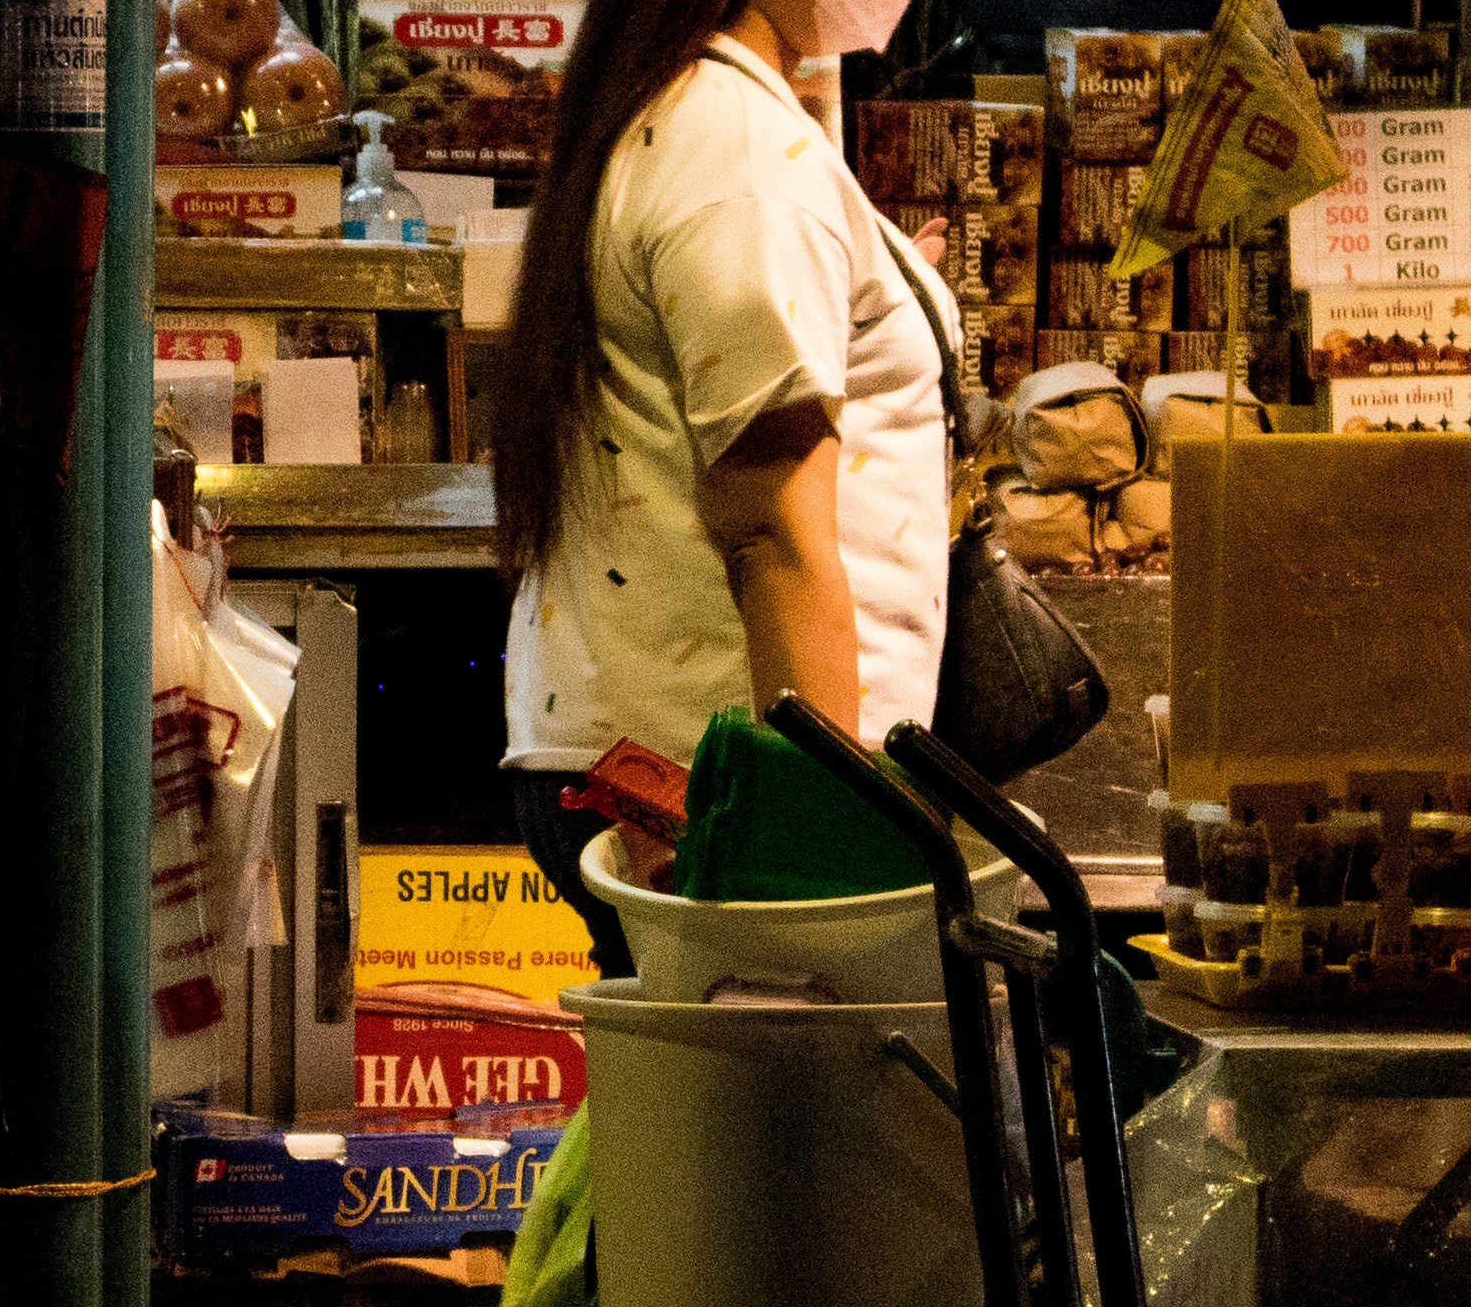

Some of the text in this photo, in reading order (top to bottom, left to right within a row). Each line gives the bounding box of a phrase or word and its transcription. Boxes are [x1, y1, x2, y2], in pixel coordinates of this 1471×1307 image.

[409, 18, 483, 44] เชียงปู
[1338, 120, 1365, 138] 00
[1381, 117, 1444, 137] Gram
[1382, 147, 1445, 165] Gram
[1383, 176, 1447, 194] Gram
[1325, 205, 1369, 225] 500
[1384, 204, 1448, 222] Gram
[1326, 235, 1370, 254] 700
[1385, 233, 1448, 252] Gram
[1344, 263, 1354, 282] 1
[1396, 260, 1441, 279] Kilo
[397, 871, 510, 902] APPLES
[358, 950, 416, 970] Meet
[425, 950, 522, 972] Passion
[355, 1055, 562, 1108] GEE WH
[334, 1148, 548, 1227] SANDHE
